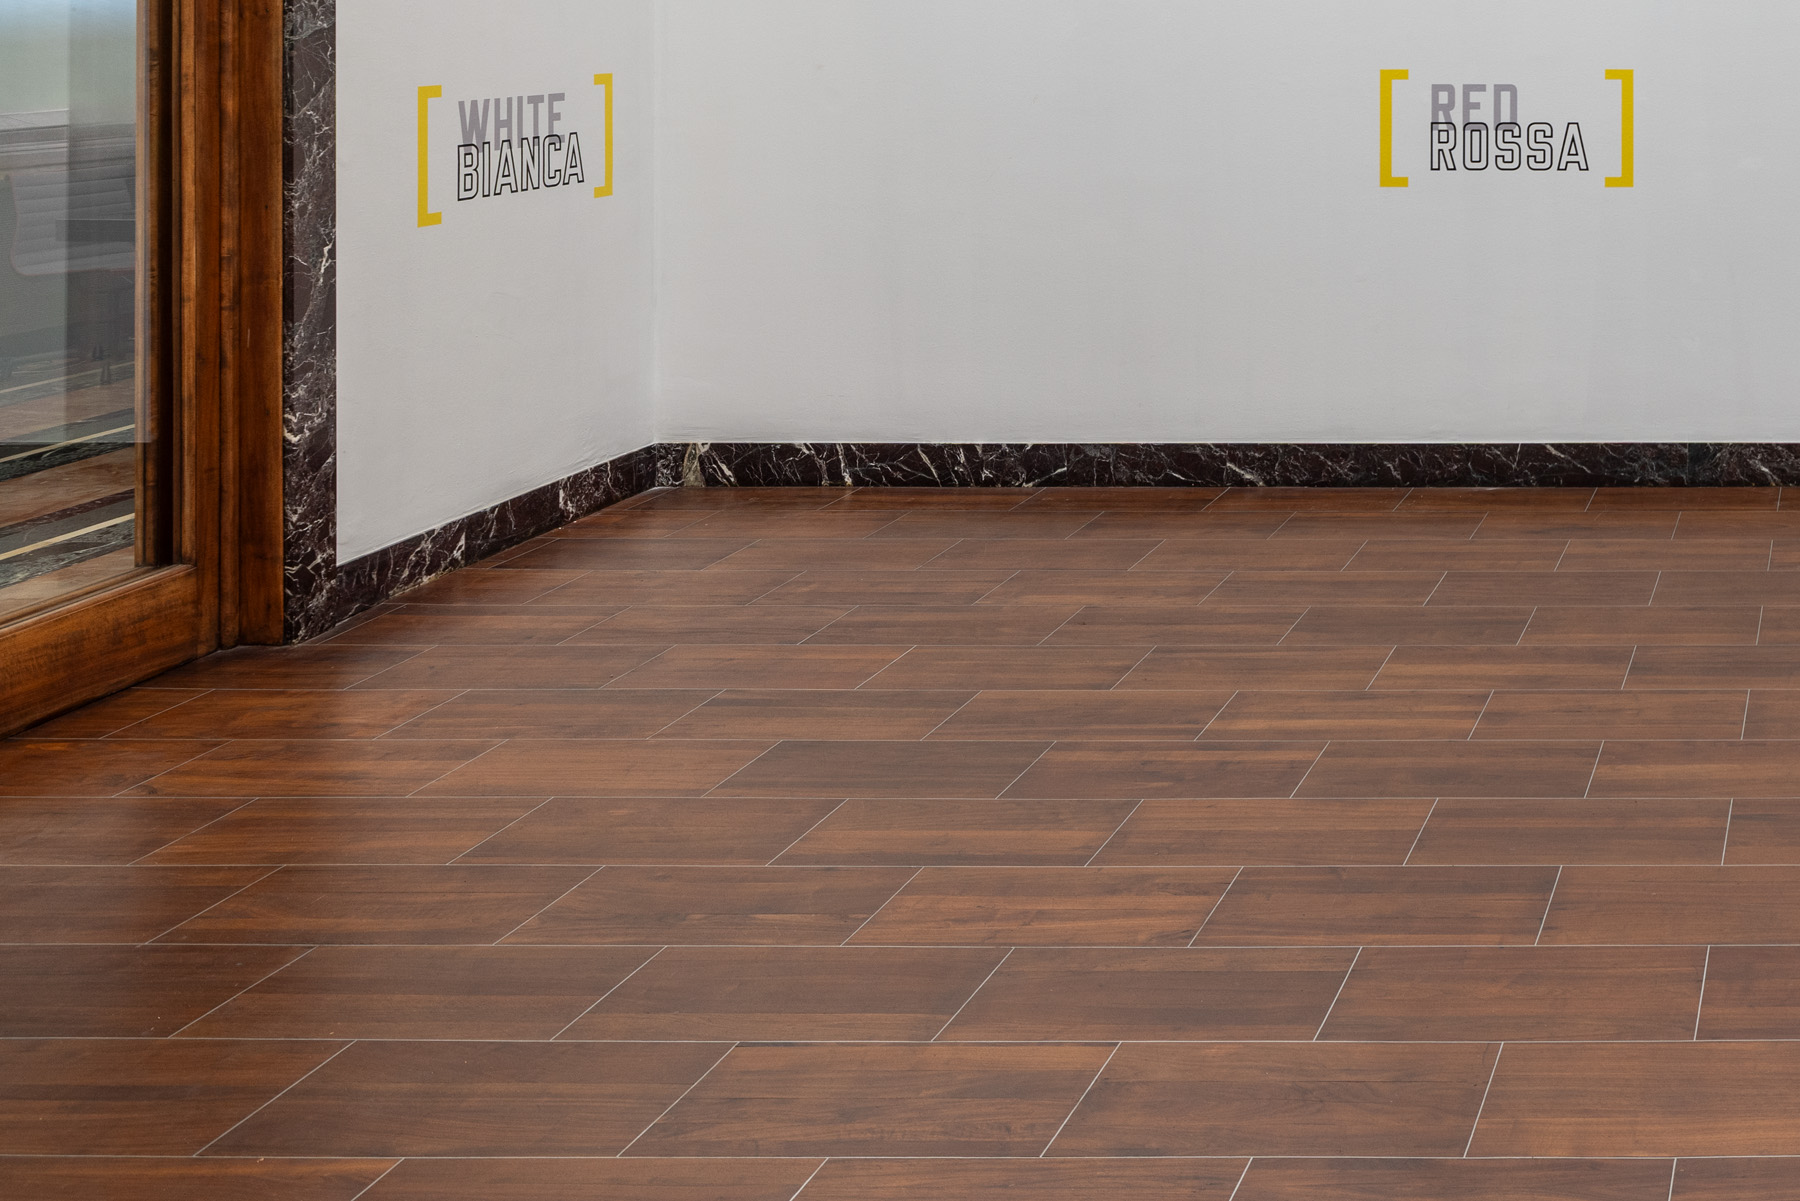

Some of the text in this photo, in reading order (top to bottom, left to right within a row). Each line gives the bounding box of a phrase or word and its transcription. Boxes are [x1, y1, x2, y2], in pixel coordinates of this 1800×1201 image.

[458, 92, 566, 152] WHITE
[1430, 84, 1518, 131] RED
[457, 132, 585, 201] BIANCA
[1430, 122, 1590, 171] ROSSA
